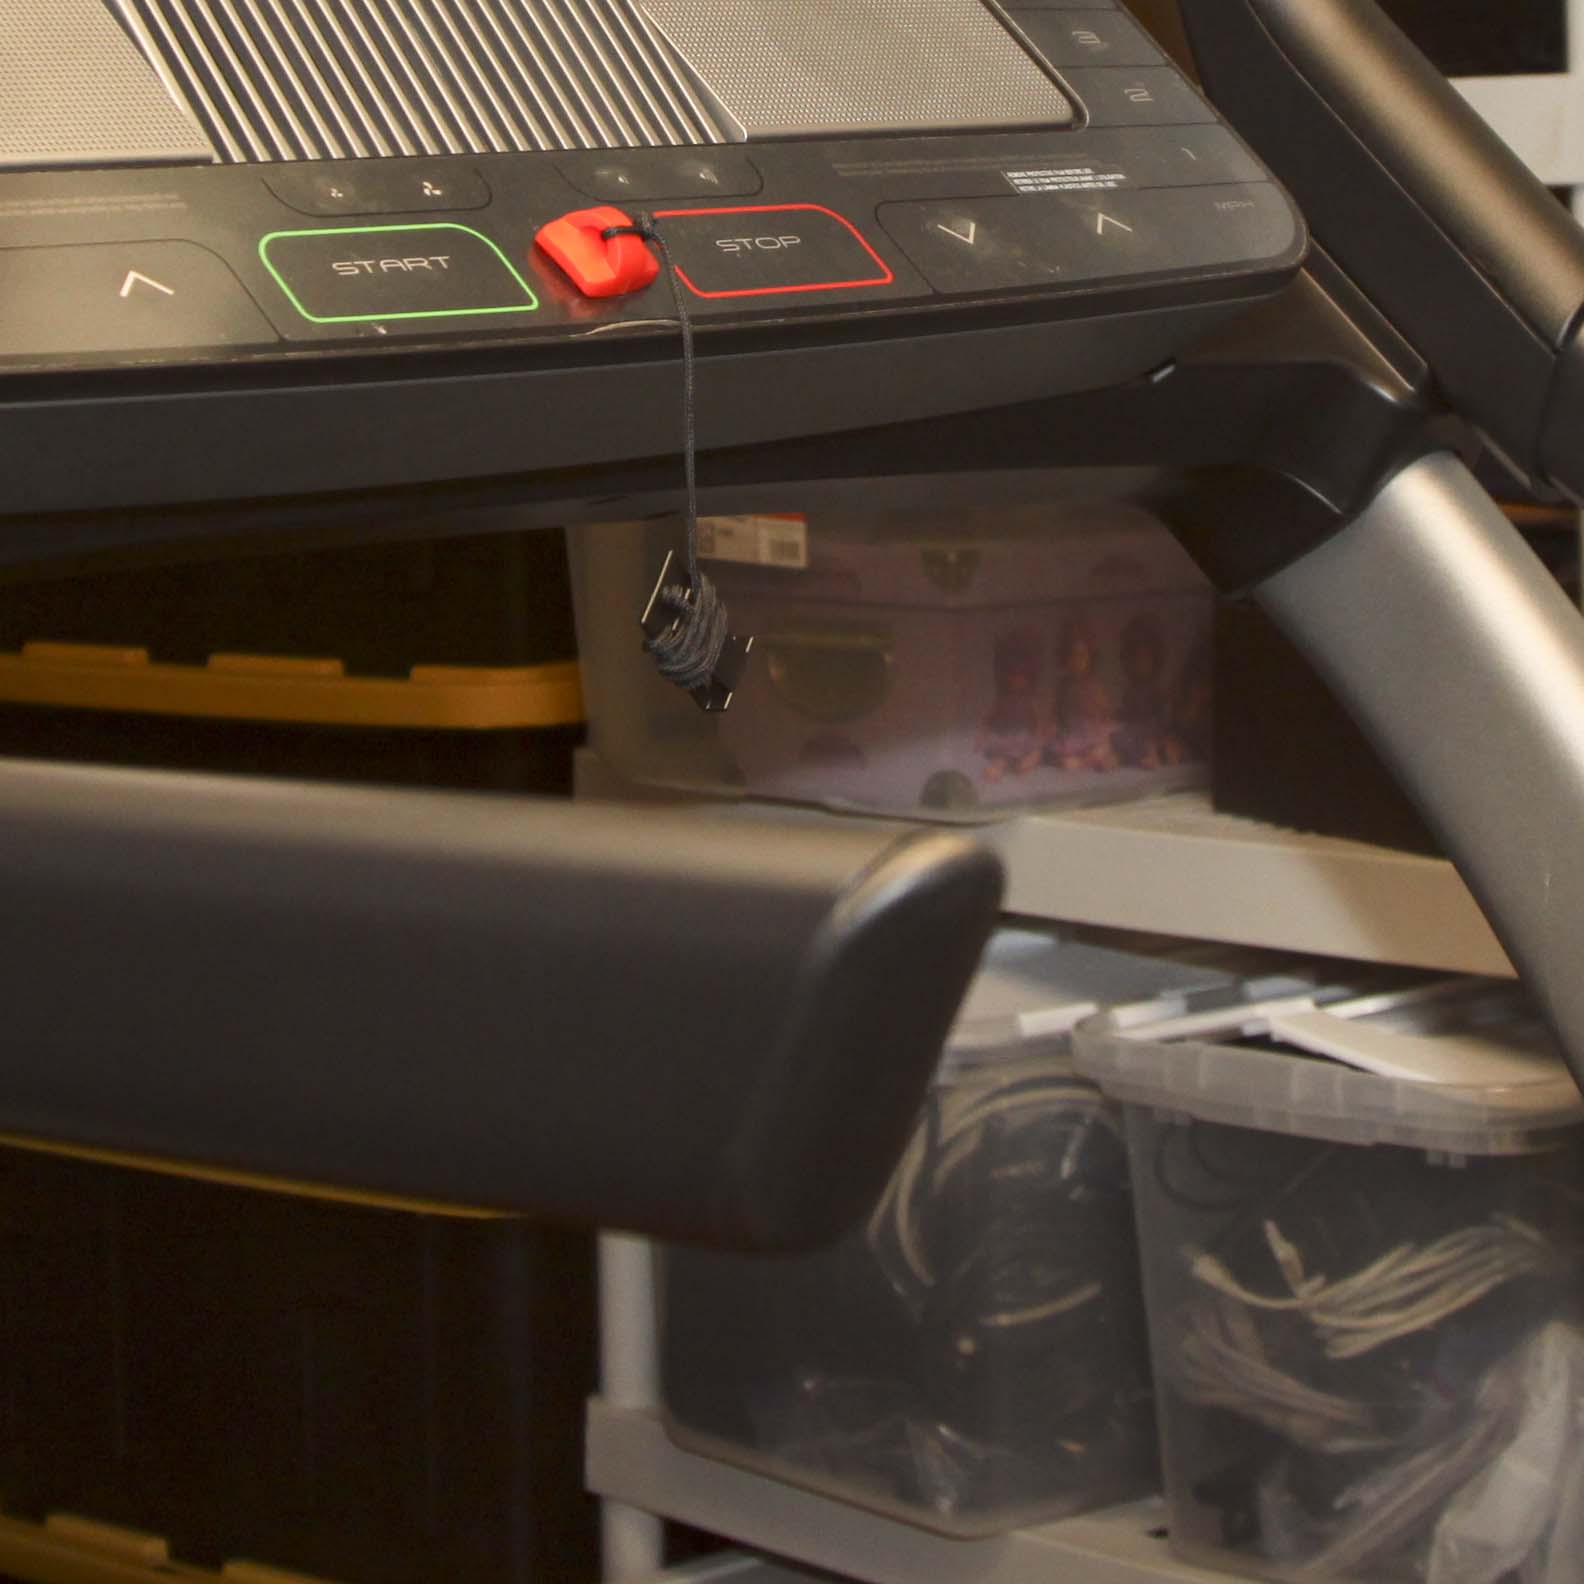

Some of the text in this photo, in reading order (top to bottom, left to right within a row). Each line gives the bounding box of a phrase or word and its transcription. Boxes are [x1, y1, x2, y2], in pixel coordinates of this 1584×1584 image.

[1071, 31, 1102, 44] 3
[1123, 88, 1155, 102] 2
[715, 234, 801, 254] STOP
[331, 255, 451, 277] START
